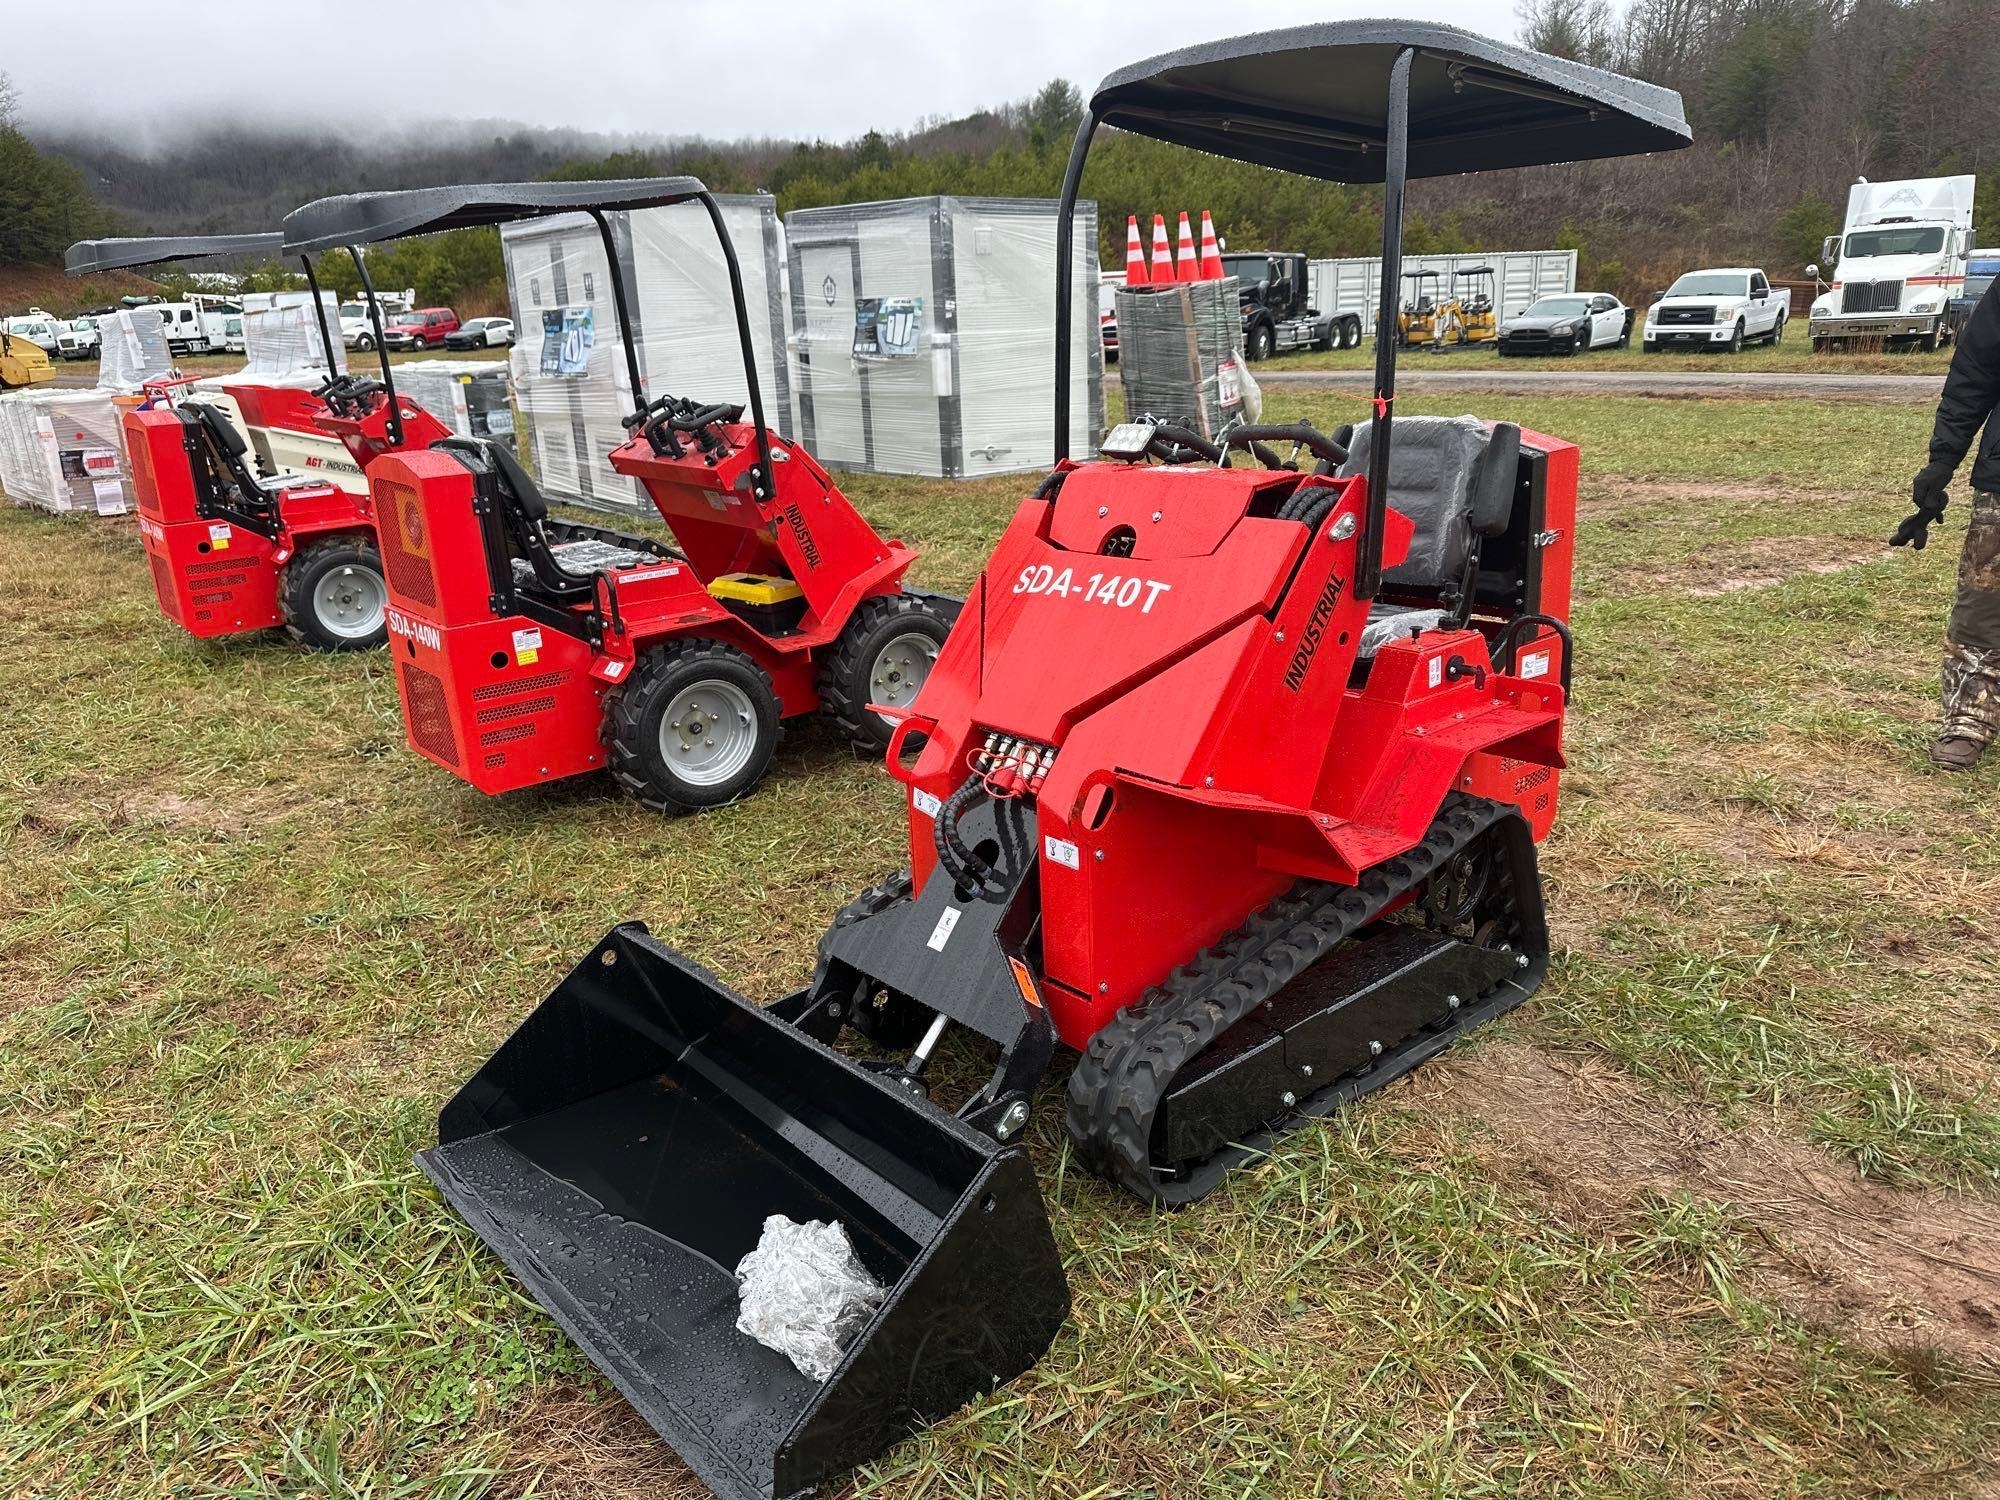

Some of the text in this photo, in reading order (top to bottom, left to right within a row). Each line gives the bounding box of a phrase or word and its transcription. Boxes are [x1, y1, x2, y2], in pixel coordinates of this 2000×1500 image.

[785, 503, 821, 570] INDUSTRIAL
[1012, 564, 1172, 614] SDA-140T
[388, 610, 441, 652] SDA-140W
[1284, 573, 1346, 692] INDUSTRIAL
